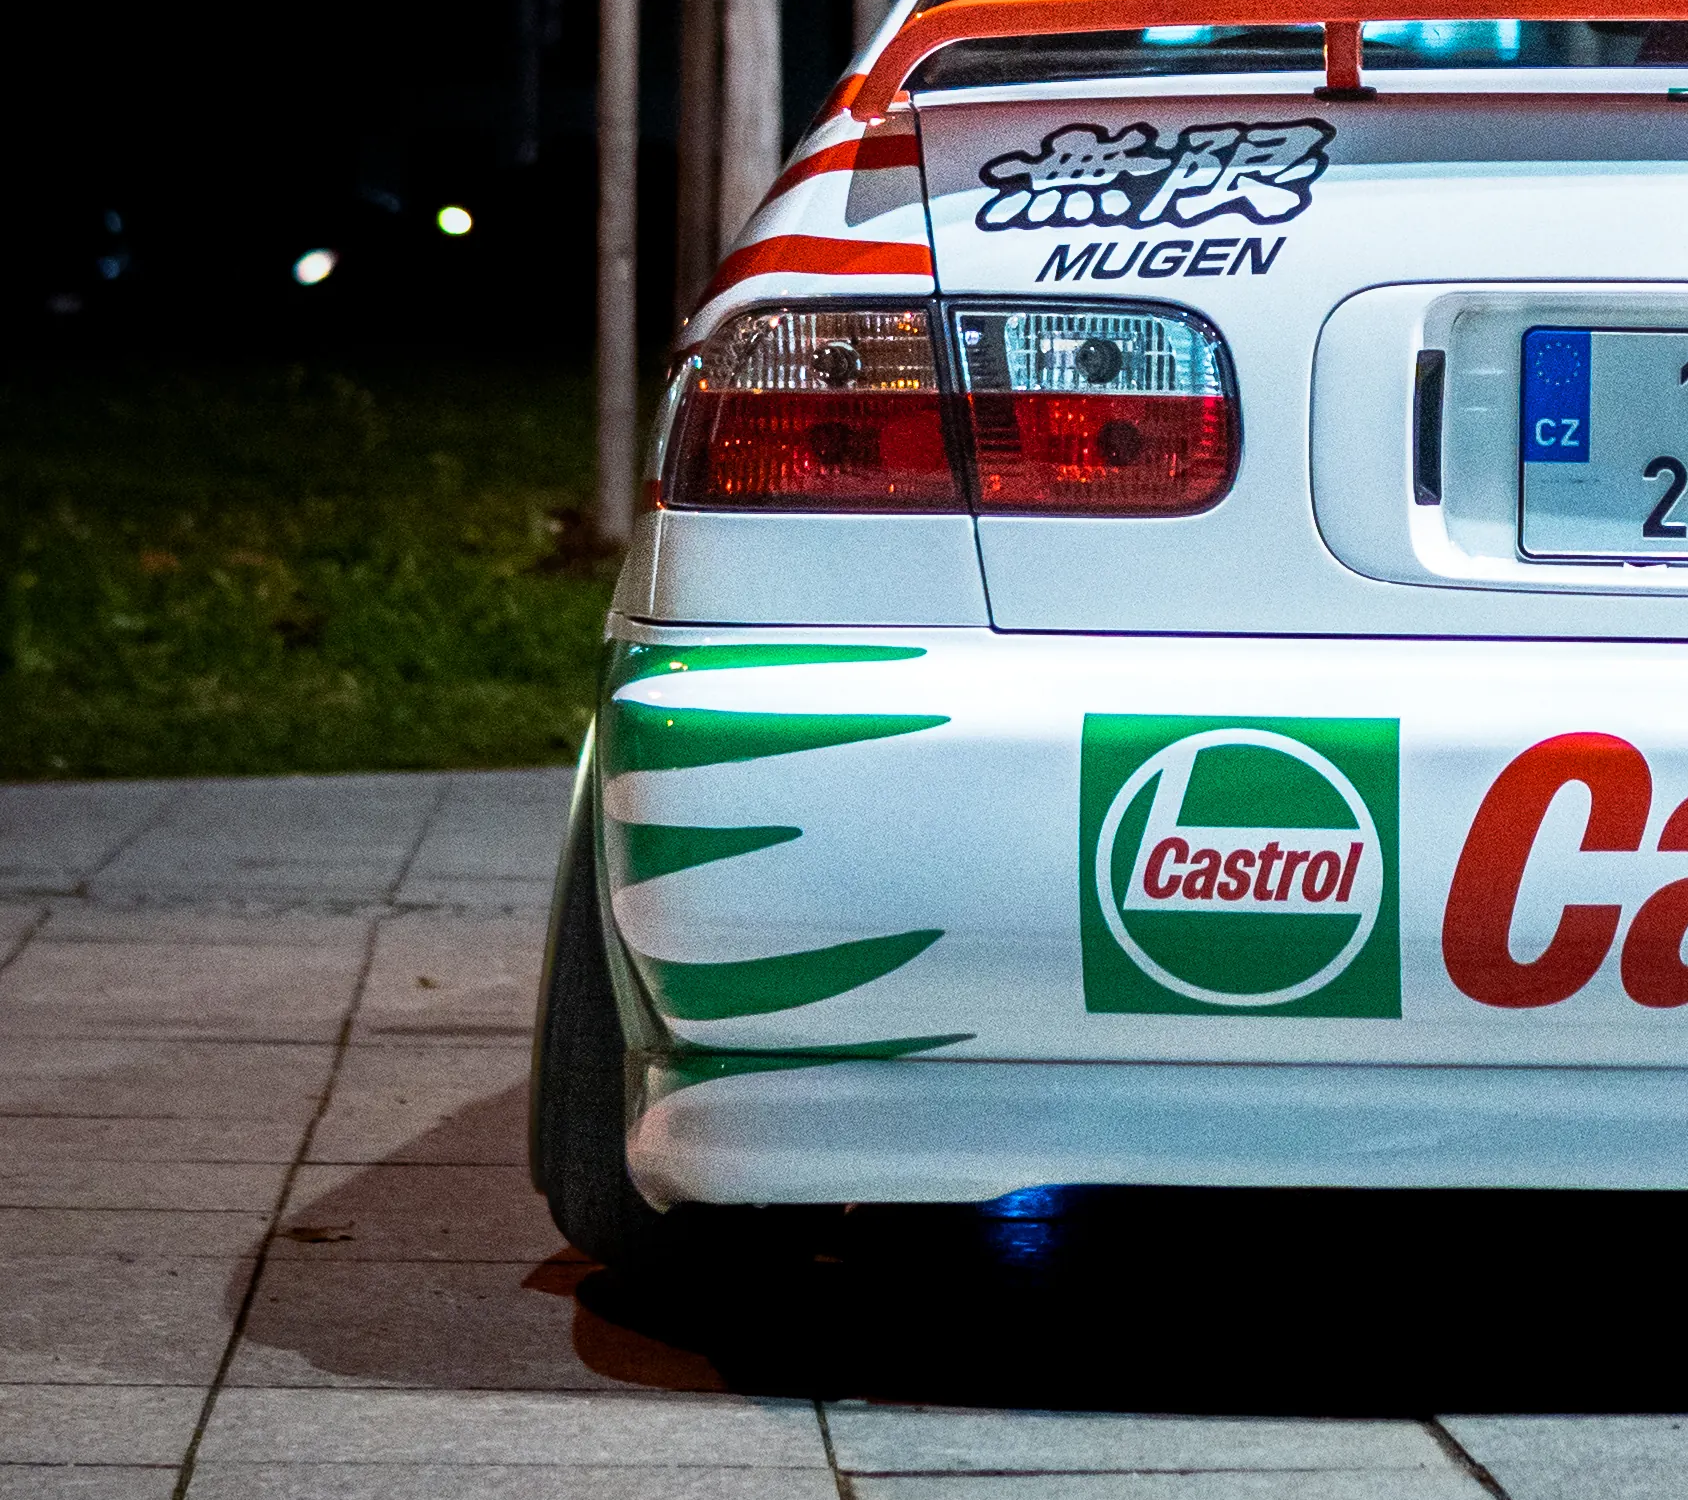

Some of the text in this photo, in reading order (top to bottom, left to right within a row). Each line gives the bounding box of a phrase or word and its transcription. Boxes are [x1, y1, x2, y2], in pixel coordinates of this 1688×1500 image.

[1035, 236, 1287, 283] MUGEN
[1534, 416, 1582, 448] CZ
[1141, 836, 1364, 903] Castrol
